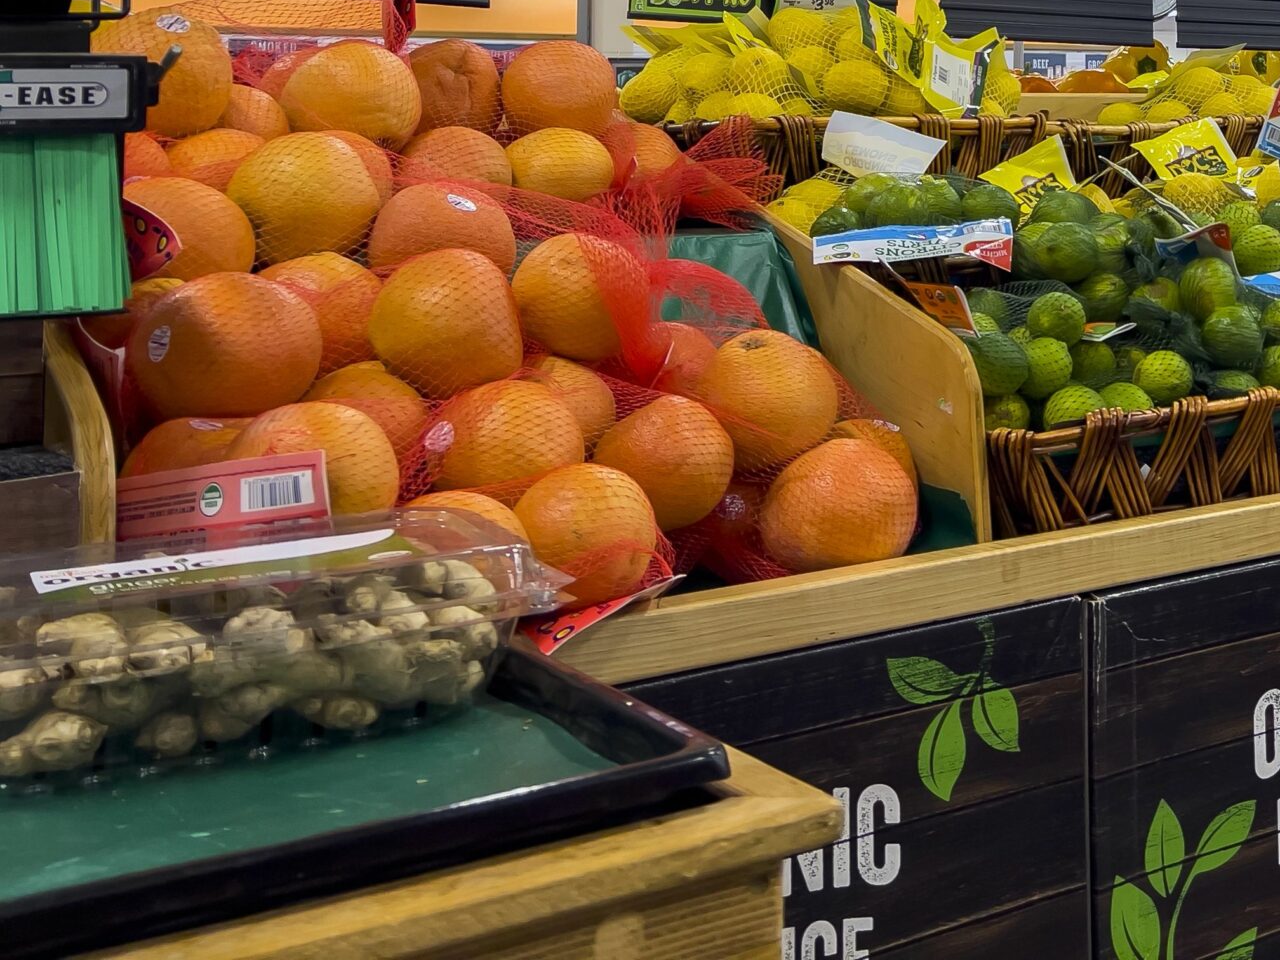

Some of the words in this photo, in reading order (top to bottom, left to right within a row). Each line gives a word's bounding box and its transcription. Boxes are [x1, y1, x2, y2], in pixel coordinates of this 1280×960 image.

[1032, 58, 1049, 69] BEEF
[874, 242, 962, 257] CITRONS
[43, 559, 220, 586] organic
[88, 575, 180, 594] ginger
